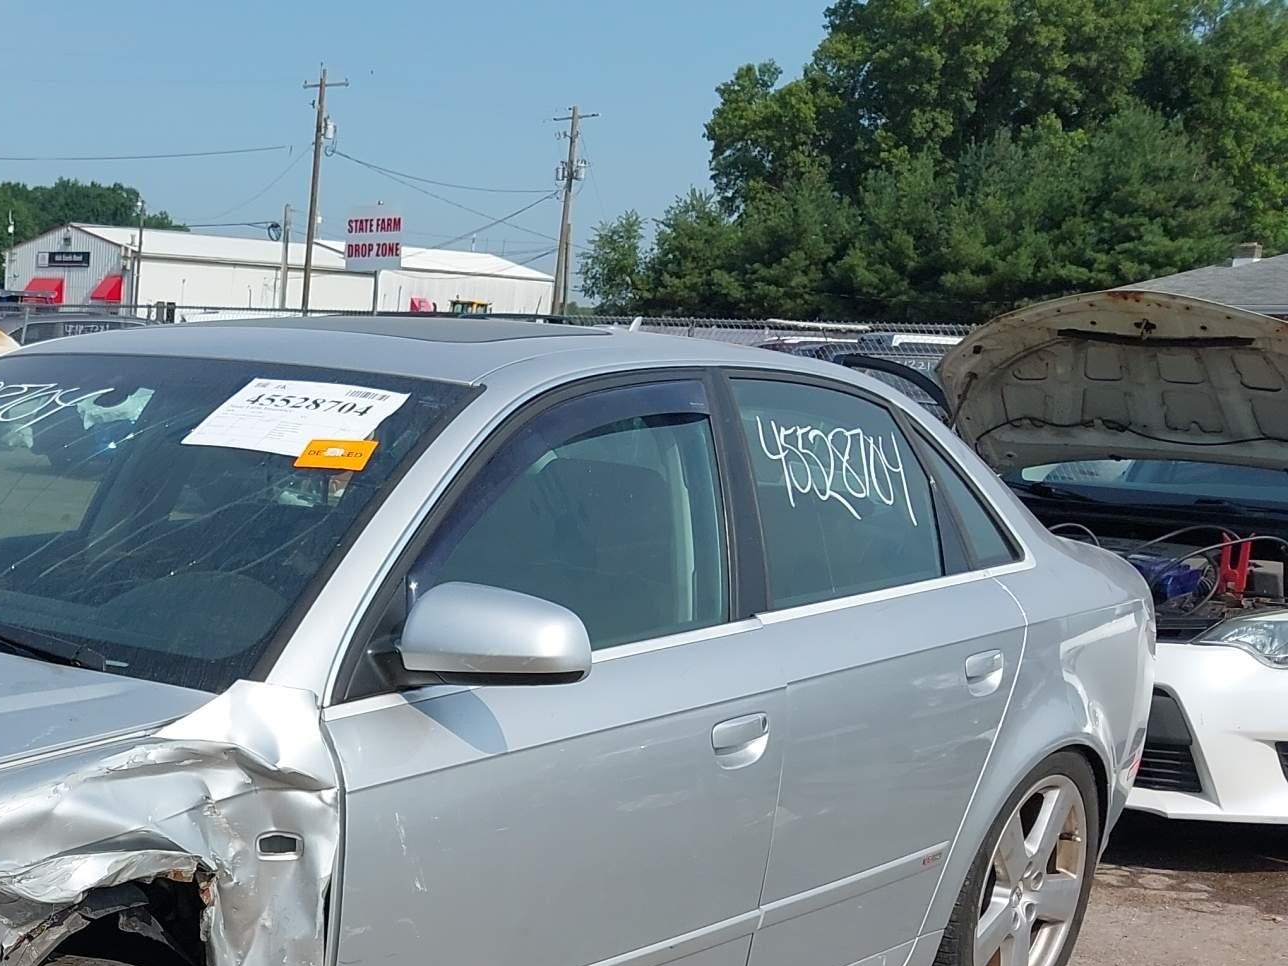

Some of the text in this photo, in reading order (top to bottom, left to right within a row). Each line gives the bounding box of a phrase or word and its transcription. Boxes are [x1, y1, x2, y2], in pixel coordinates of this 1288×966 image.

[347, 217, 401, 234] STATE FARM
[347, 242, 400, 258] DROP ZONE
[245, 393, 374, 417] 45528704
[755, 415, 918, 527] 45528704
